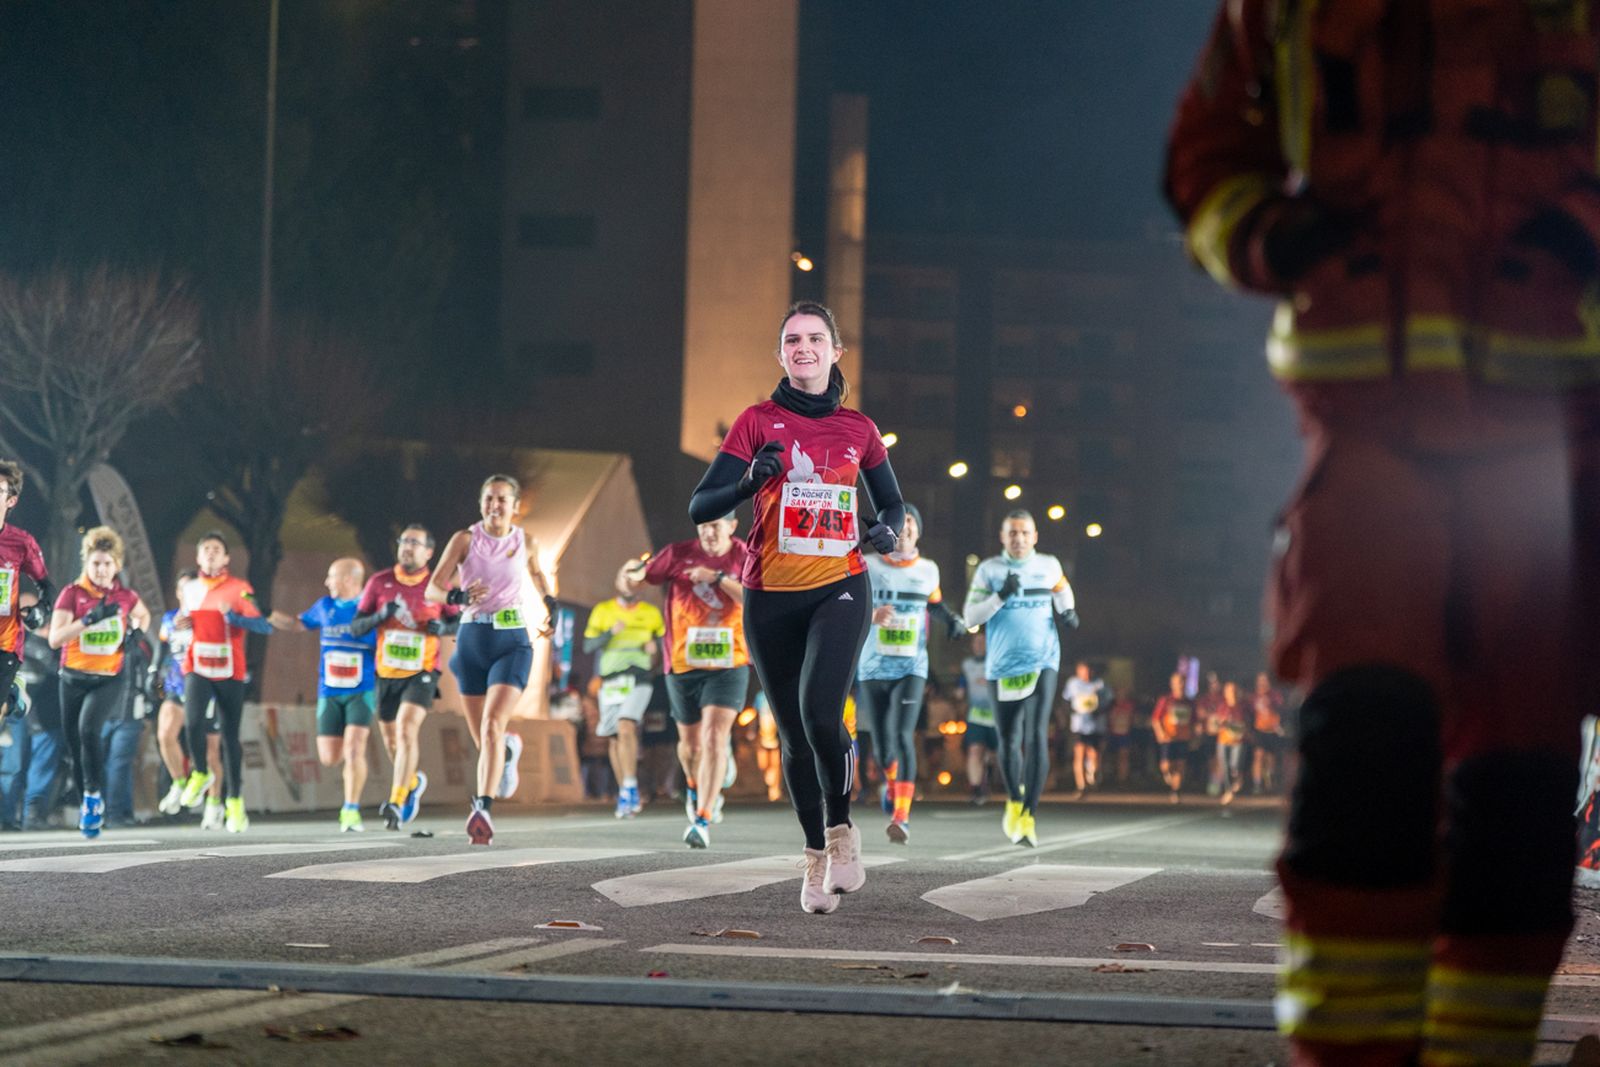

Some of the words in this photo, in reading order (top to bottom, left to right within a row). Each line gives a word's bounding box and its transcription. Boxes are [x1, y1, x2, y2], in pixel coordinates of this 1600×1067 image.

[801, 491, 823, 499] NOCHE
[823, 491, 833, 500] DE
[790, 499, 806, 507] SAN
[695, 642, 724, 657] 9473
